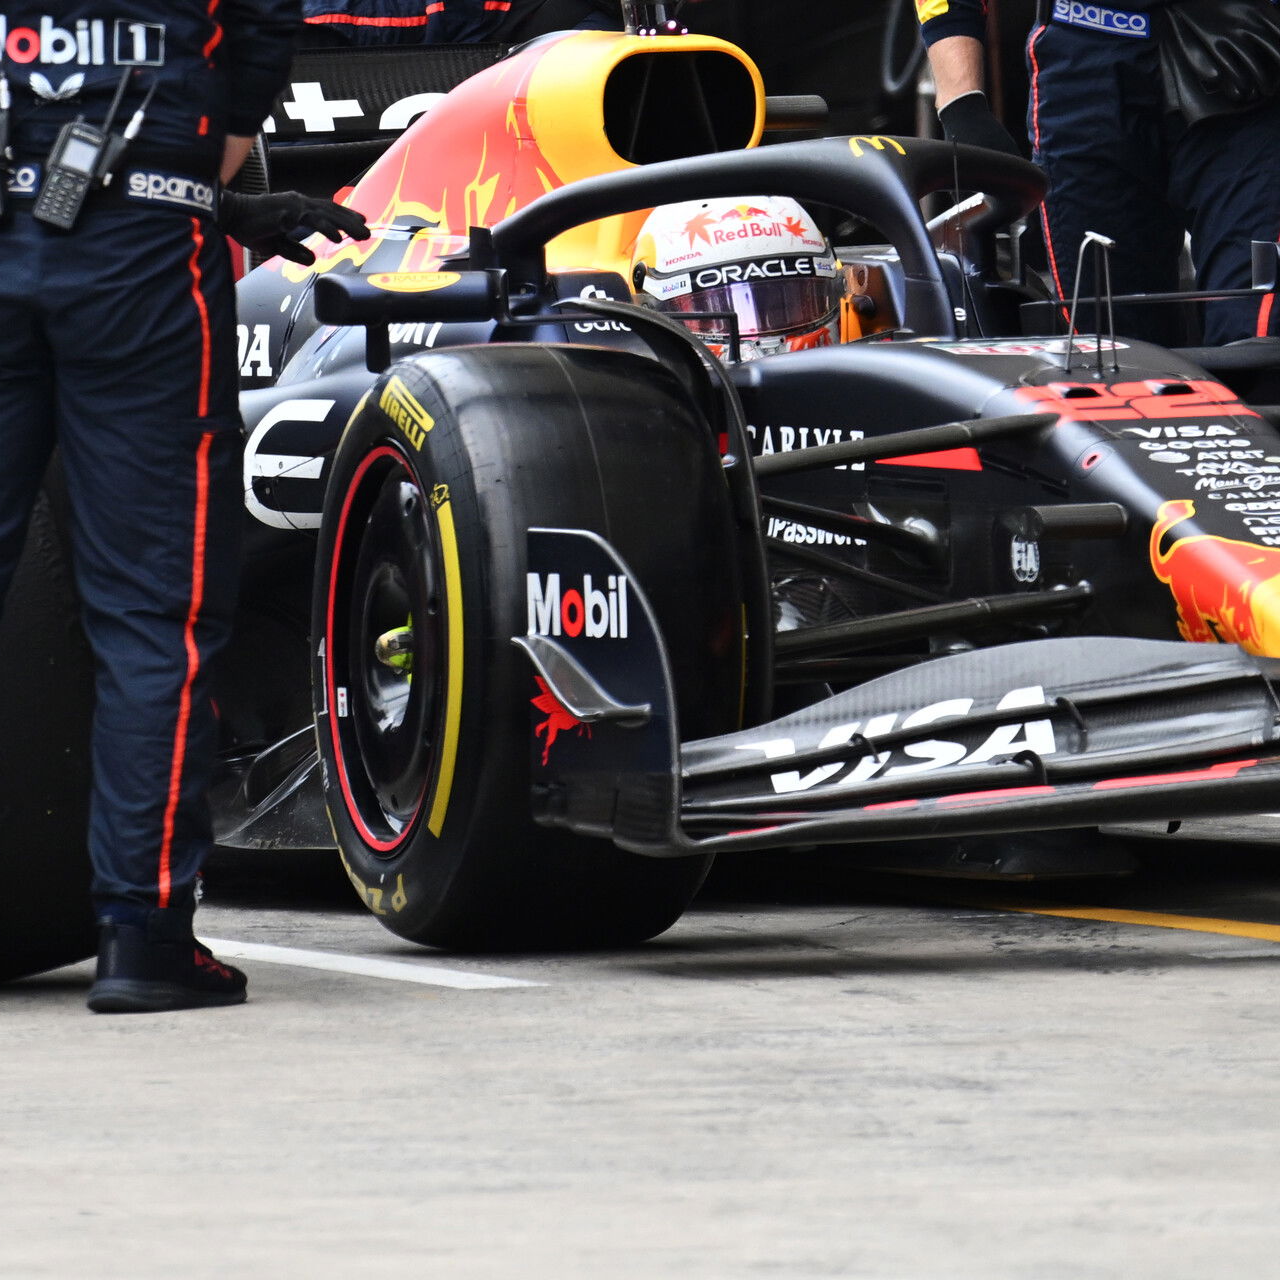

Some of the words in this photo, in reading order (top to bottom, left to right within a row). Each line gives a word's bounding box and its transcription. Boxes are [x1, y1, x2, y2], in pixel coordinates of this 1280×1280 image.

[129, 172, 214, 212] sparco
[713, 223, 748, 245] Red
[751, 222, 782, 238] Bull
[665, 251, 703, 266] HONDA
[696, 258, 811, 288] ORACLE
[1122, 425, 1237, 439] VISA
[527, 573, 628, 639] Mobil
[735, 685, 1058, 794] VISA
